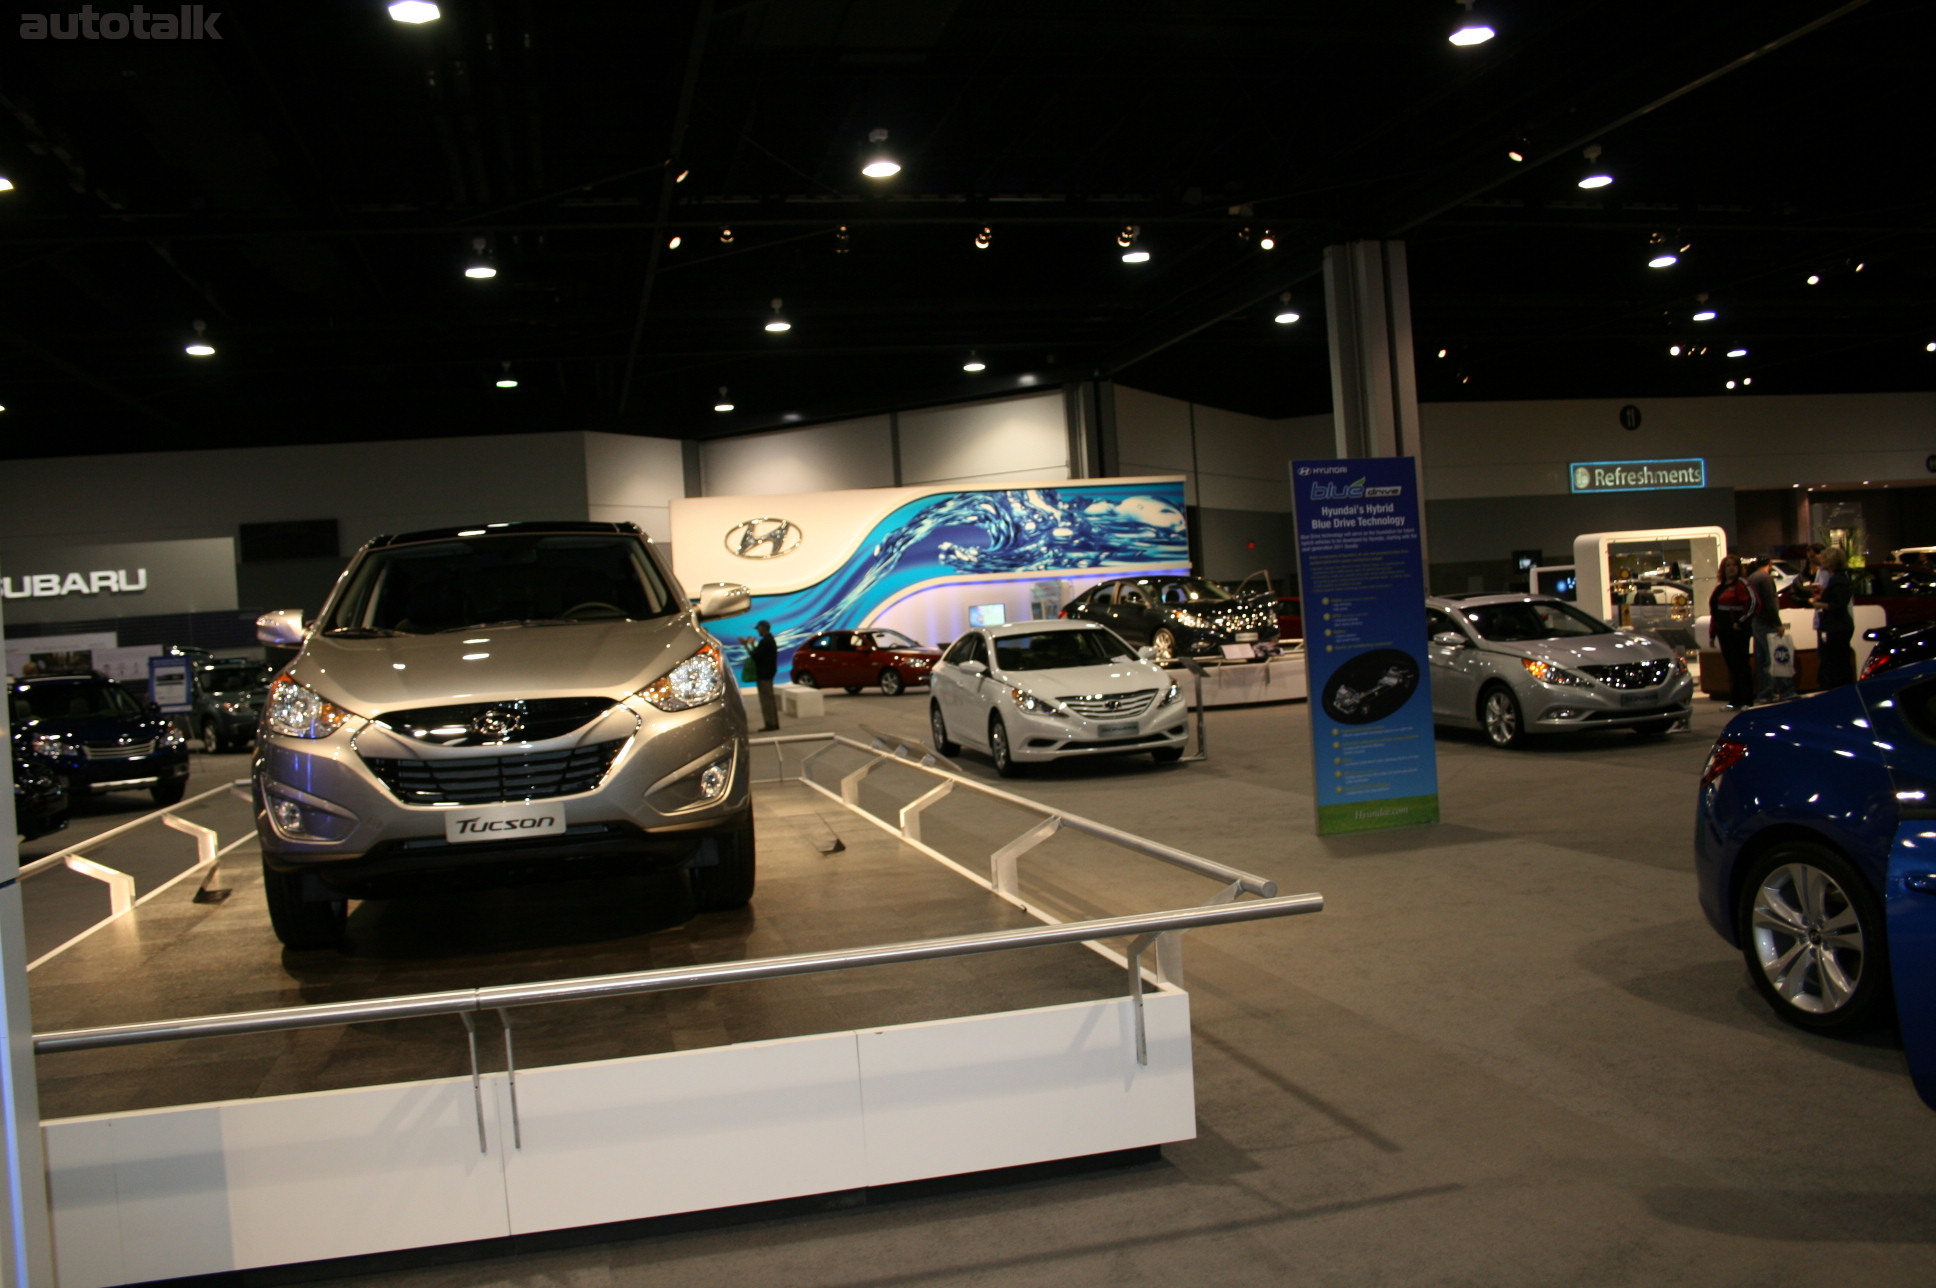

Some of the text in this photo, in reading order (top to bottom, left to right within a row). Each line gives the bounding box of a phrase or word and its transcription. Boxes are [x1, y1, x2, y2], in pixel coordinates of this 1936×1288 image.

[1312, 466, 1348, 475] HYUNDAI
[1594, 466, 1701, 486] Refreshments
[1310, 480, 1400, 500] blue drive
[1321, 502, 1394, 519] Hyundai's Hybrid
[1311, 515, 1406, 530] Blue Drive Technology
[0, 567, 147, 599] UBARU
[1355, 806, 1409, 821] Hyundai.com
